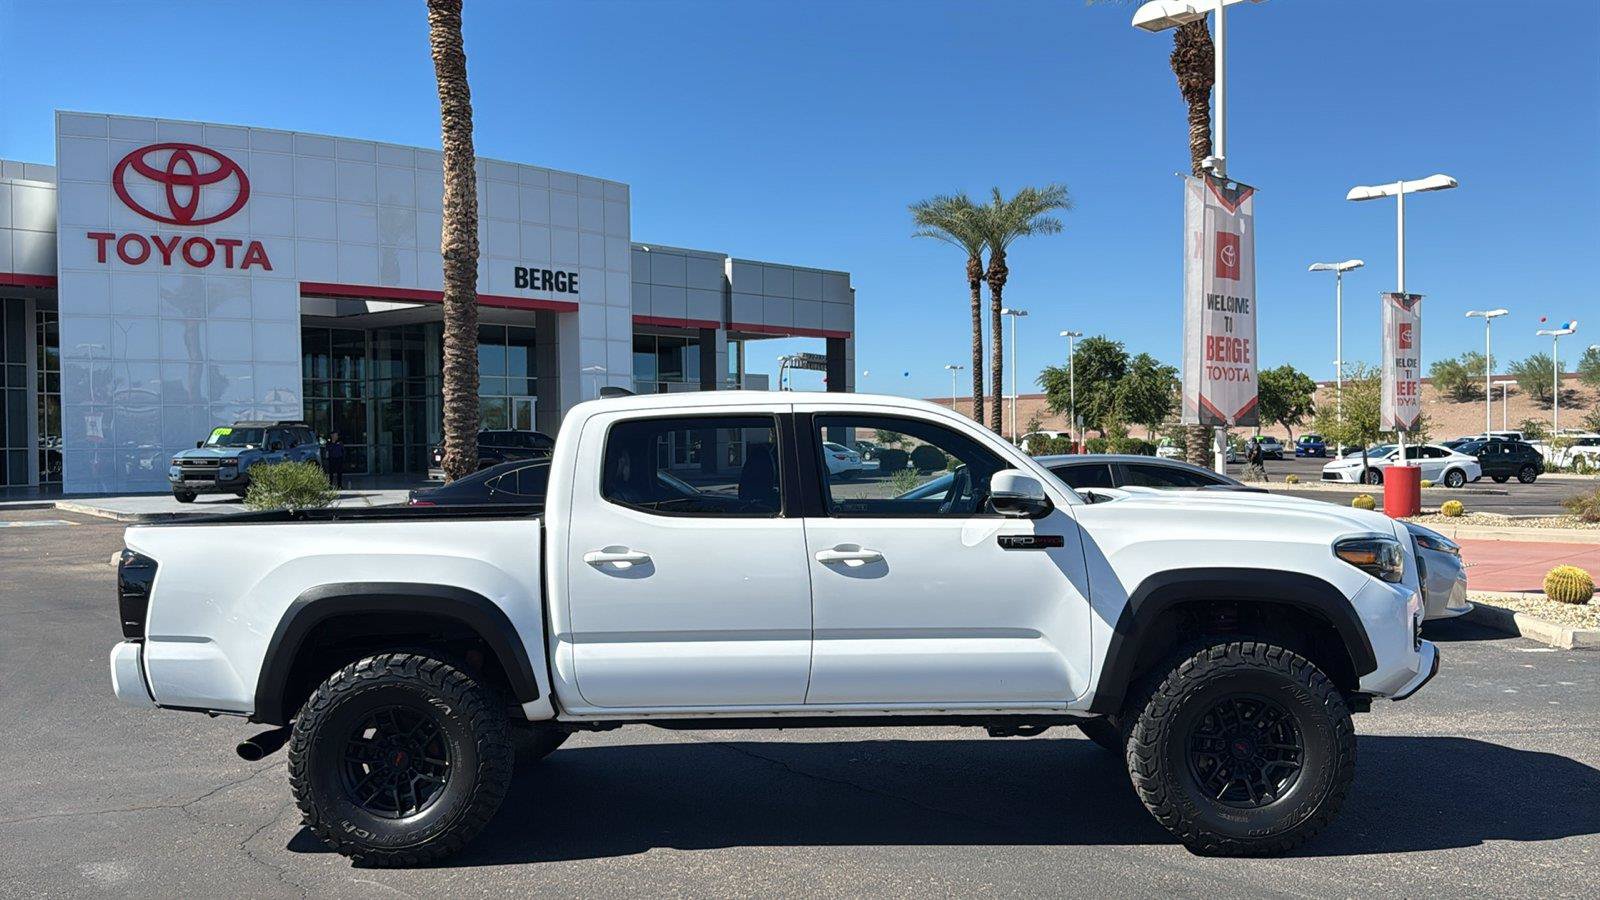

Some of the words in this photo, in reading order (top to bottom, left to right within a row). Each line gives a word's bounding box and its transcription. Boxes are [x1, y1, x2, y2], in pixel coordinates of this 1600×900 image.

[87, 232, 273, 271] TOYOTA
[514, 266, 579, 294] BERGE
[1206, 293, 1250, 314] WELCOME
[1206, 335, 1250, 364] BERGE
[1206, 366, 1250, 383] TOYOTA
[1000, 537, 1034, 545] TRD
